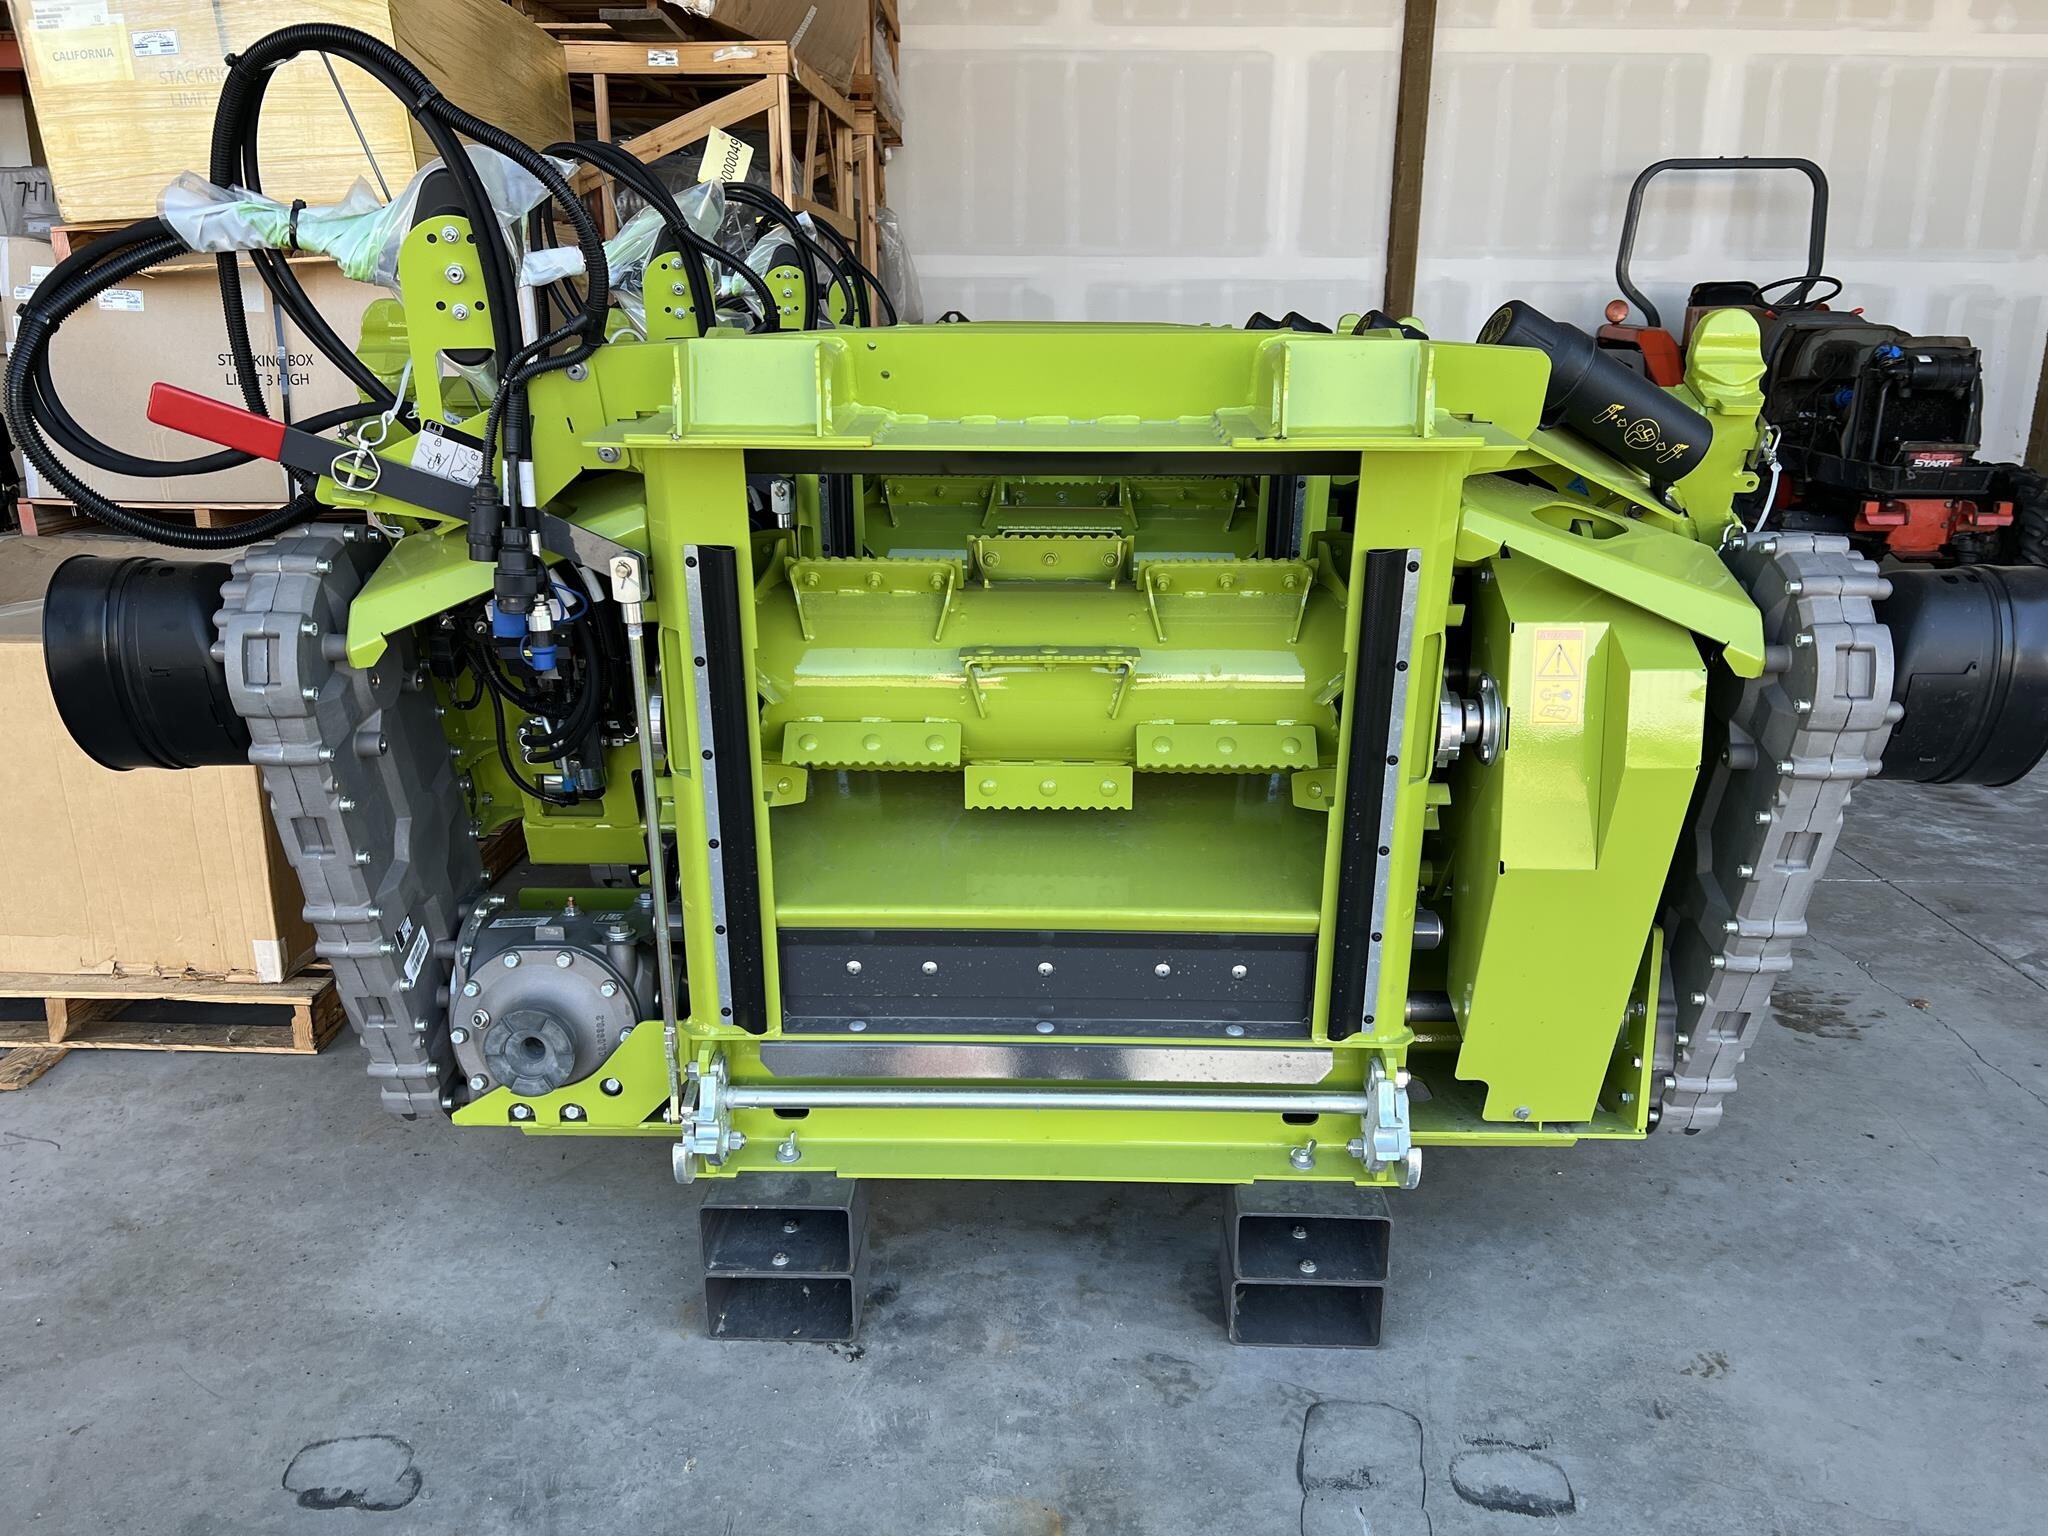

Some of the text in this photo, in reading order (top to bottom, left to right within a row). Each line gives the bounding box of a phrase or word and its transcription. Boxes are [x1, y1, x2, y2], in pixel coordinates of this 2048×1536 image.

[52, 47, 114, 62] CALIFORNIA
[168, 91, 209, 106] LIMIT
[217, 353, 314, 367] STKIN BOX
[266, 374, 274, 386] 3
[1912, 459, 1955, 468] START
